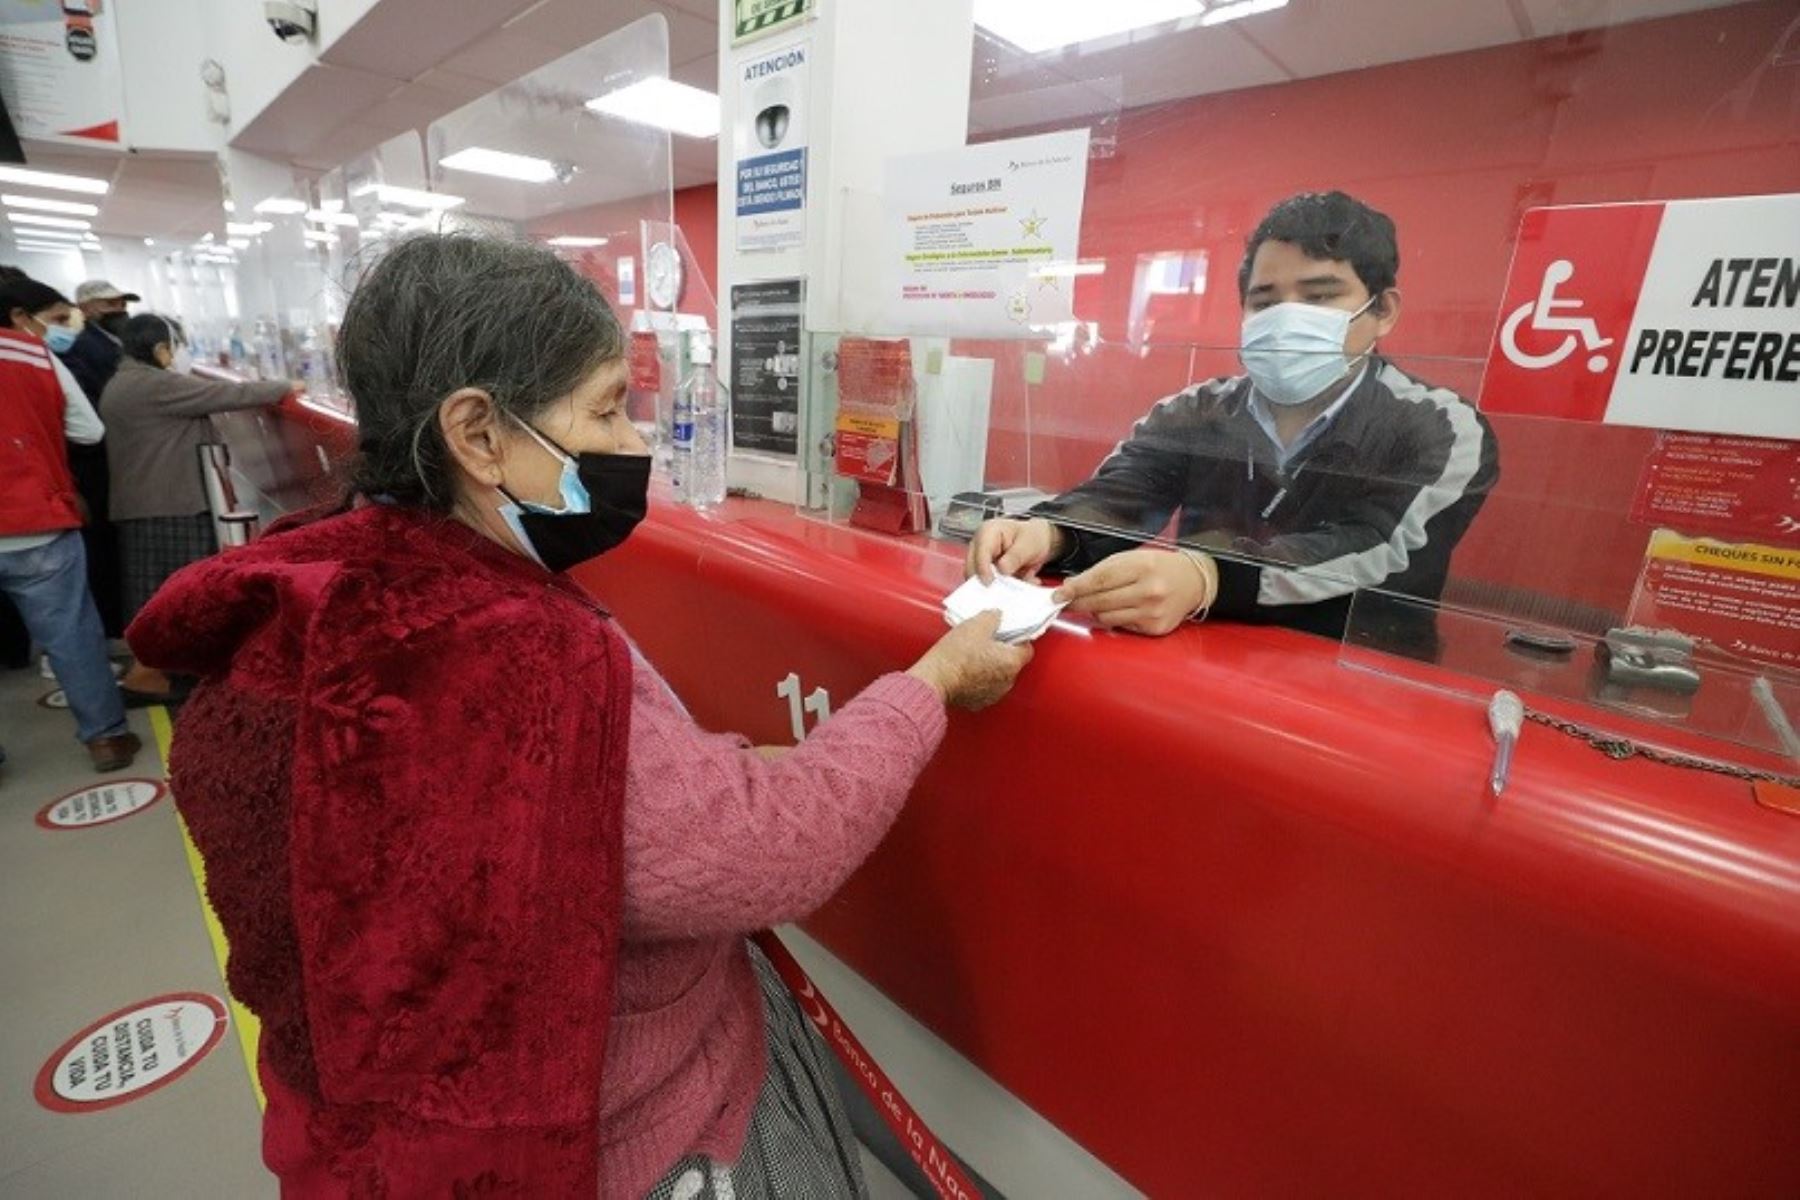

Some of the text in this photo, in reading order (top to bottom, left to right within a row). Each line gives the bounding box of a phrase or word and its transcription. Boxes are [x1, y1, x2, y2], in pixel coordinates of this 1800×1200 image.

[744, 47, 805, 82] ATENCIÓN
[950, 177, 1002, 196] Seguros BN
[1691, 257, 1800, 308] ATEN
[1629, 329, 1800, 383] PREFERE
[1694, 545, 1758, 561] CHEQUES
[1761, 554, 1785, 566] SIN
[777, 672, 831, 742] 11
[91, 1035, 112, 1092] CUIDA TU
[136, 1017, 159, 1072] CUIDA TU
[68, 1056, 88, 1090] VIDA
[882, 1090, 903, 1123] de
[906, 1117, 924, 1150] la
